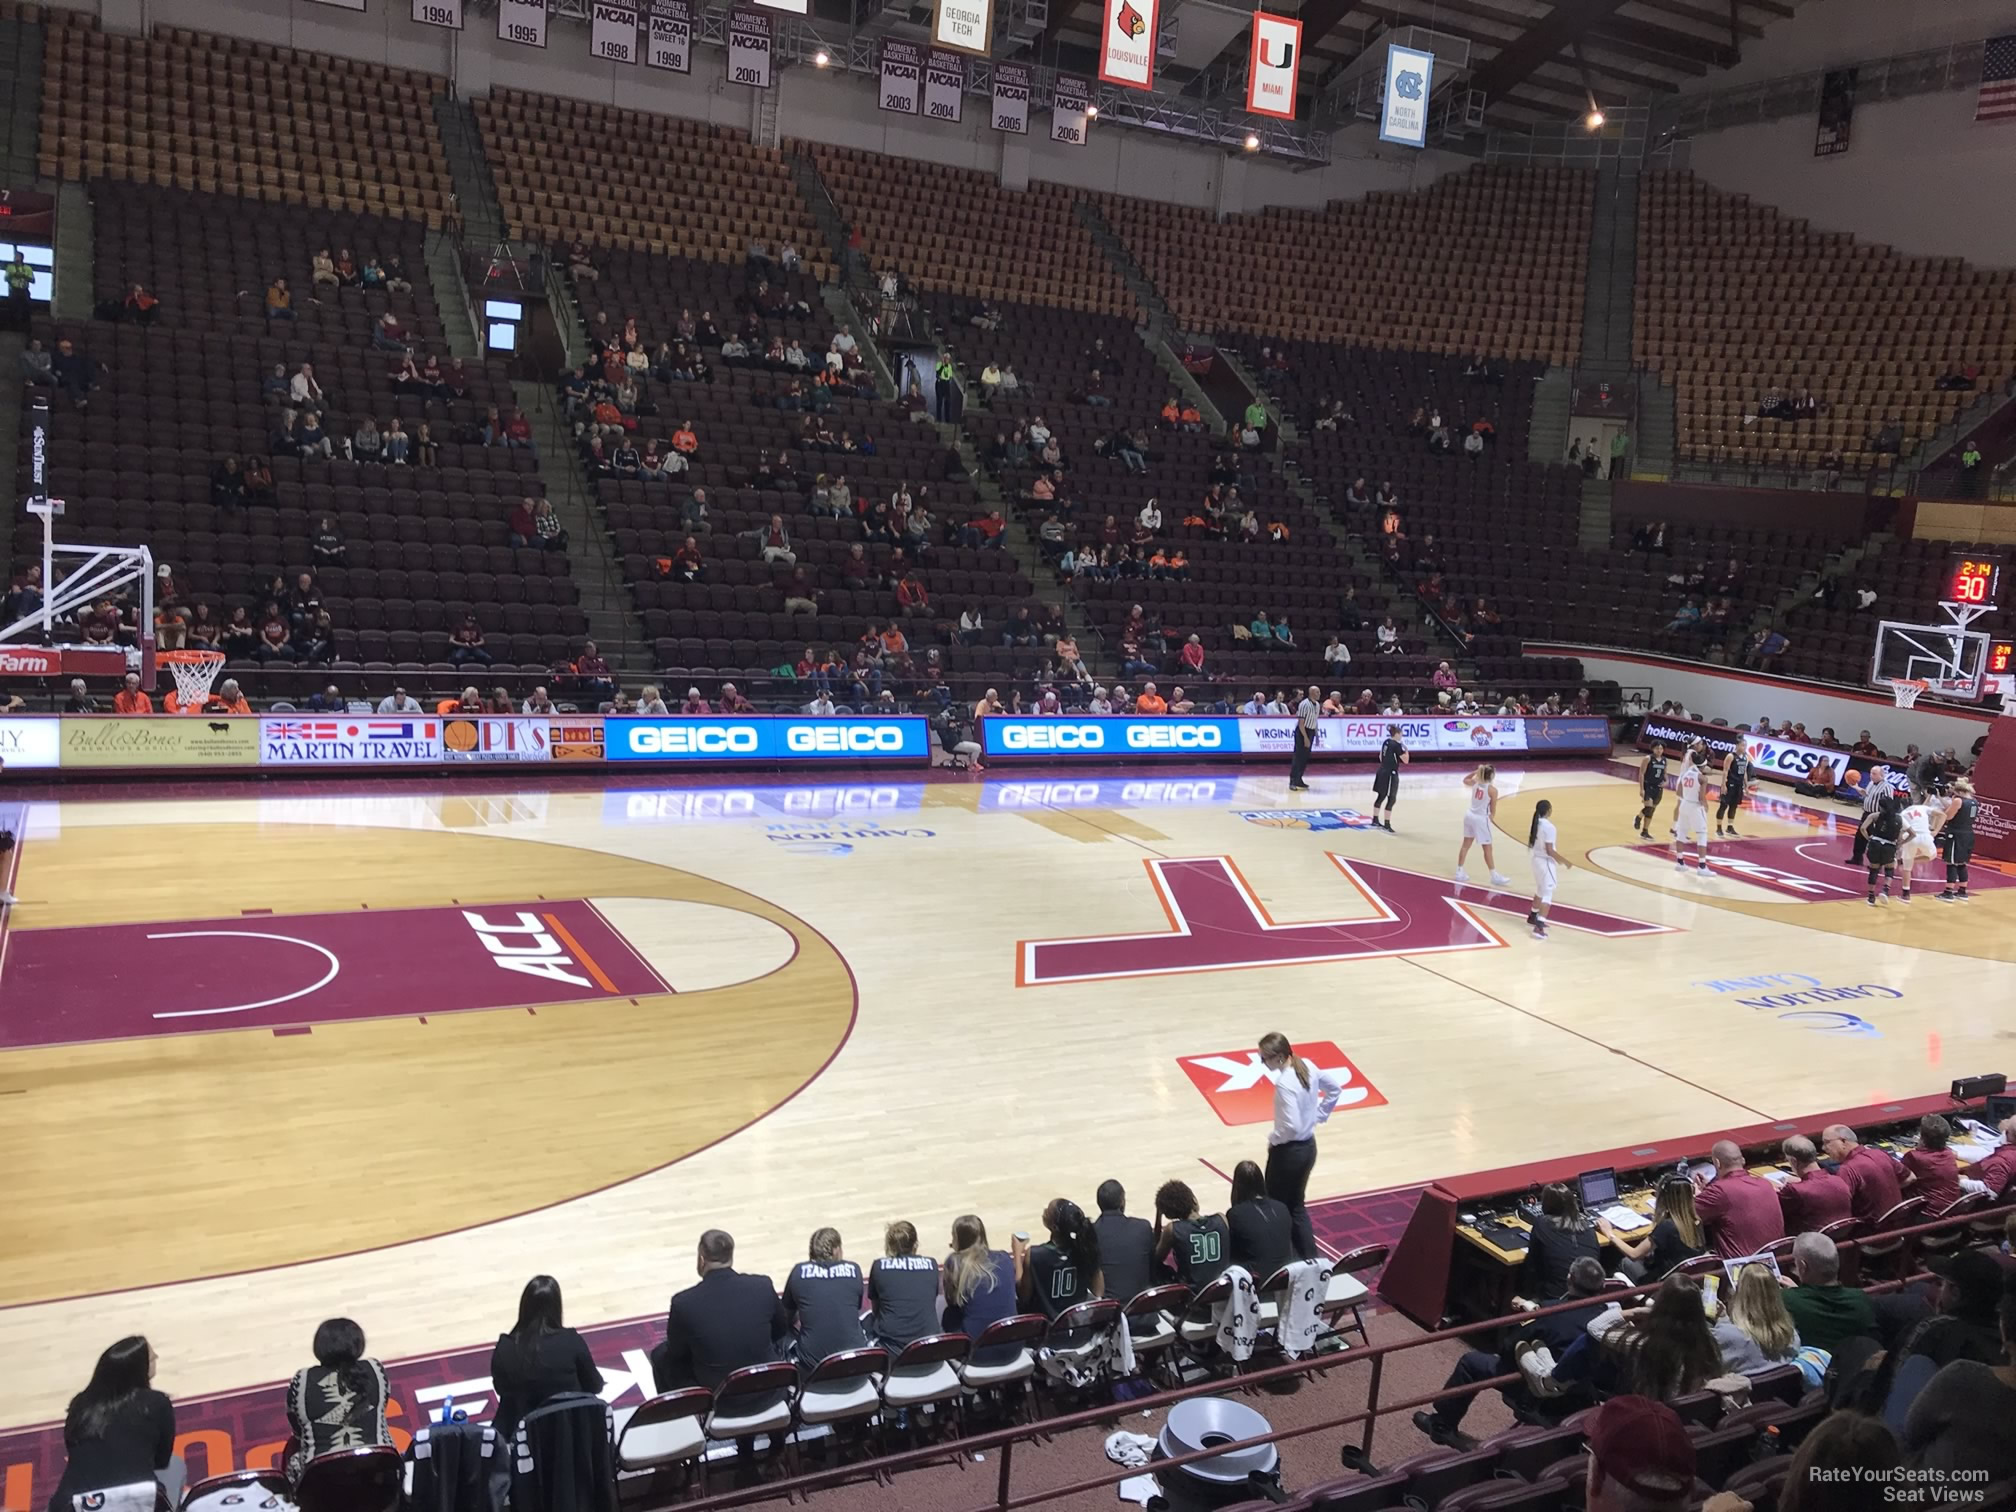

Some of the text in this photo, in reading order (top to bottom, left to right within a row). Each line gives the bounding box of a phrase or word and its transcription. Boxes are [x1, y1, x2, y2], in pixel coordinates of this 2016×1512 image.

[422, 5, 454, 25] 1994
[595, 8, 635, 27] NCAA
[651, 3, 690, 20] BASKETBALL
[734, 12, 767, 26] WOMEN'S
[945, 6, 981, 25] GEORGIA
[507, 23, 538, 43] 1995
[651, 18, 688, 37] NCAA
[730, 21, 771, 36] BASKETBALL
[951, 21, 973, 37] TECH
[653, 31, 686, 46] SWEET 16
[731, 35, 769, 53] NCAA
[600, 41, 629, 60] 1998
[883, 50, 920, 64] BASKETBALL
[887, 42, 917, 55] WOMEN'S
[932, 50, 961, 64] WOMEN'S
[656, 50, 682, 68] 1999
[928, 58, 962, 73] BASKETBALL
[1108, 47, 1149, 68] LOUISVILLE
[735, 67, 761, 84] 2001
[884, 63, 917, 81] NCAA
[995, 73, 1030, 86] BASKETBALL
[999, 65, 1027, 77] WOMEN'S
[928, 71, 961, 89] NCAA
[1060, 77, 1087, 89] WOMEN'S
[995, 85, 1027, 102] NCAA
[1056, 84, 1089, 98] BASKETBALL
[1262, 82, 1284, 97] MIAMI
[886, 94, 912, 111] 2003
[930, 102, 954, 119] 2004
[1056, 97, 1086, 113] NCAA
[1394, 105, 1417, 119] NORTH
[998, 115, 1021, 131] 2005
[1388, 116, 1420, 132] CAROLINA
[1057, 126, 1080, 142] 2006
[1962, 561, 1991, 576] 2:14
[1956, 575, 1985, 600] 30
[0, 653, 48, 673] Farm
[1992, 656, 2007, 670] 30
[629, 726, 758, 753] GEICO
[787, 726, 904, 752] GEICO
[1002, 725, 1105, 749] GEICO
[1126, 724, 1222, 748] GEICO
[1646, 724, 1737, 752] hokietics.com
[267, 741, 440, 760] MARTIN TRAVEL
[1683, 777, 1695, 788] 20
[1474, 788, 1484, 800] 10
[1906, 810, 1922, 820] 14
[461, 909, 593, 989] ACC
[1190, 1231, 1221, 1265] 30
[800, 1263, 857, 1279] TEAM FIRST
[880, 1256, 934, 1271] TEAM FIRST
[1051, 1266, 1077, 1299] 10
